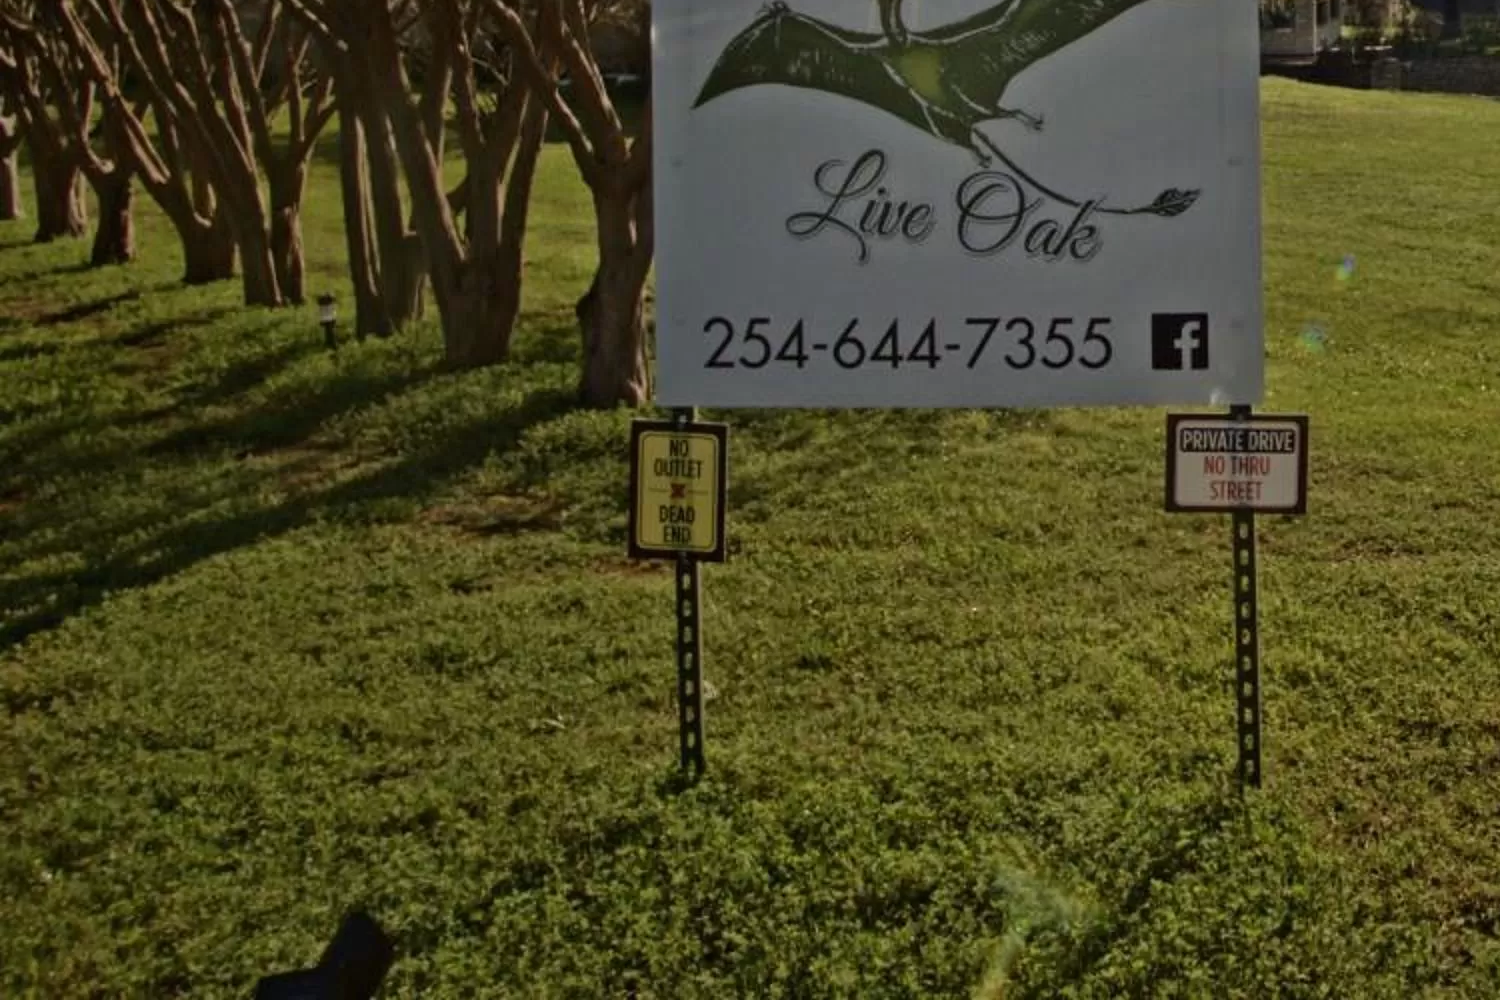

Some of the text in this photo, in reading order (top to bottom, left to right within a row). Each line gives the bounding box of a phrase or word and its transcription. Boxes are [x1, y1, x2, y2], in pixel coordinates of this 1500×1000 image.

[786, 148, 1104, 264] Live Oak
[703, 316, 1113, 371] 254-644-7355
[669, 439, 689, 457] NO
[1183, 429, 1293, 451] PRIVATE DRIVE
[653, 458, 703, 479] OUTLET
[1204, 455, 1271, 476] NO THRU
[1209, 480, 1263, 501] STREET
[659, 504, 696, 525] DEAD
[663, 525, 692, 544] END
